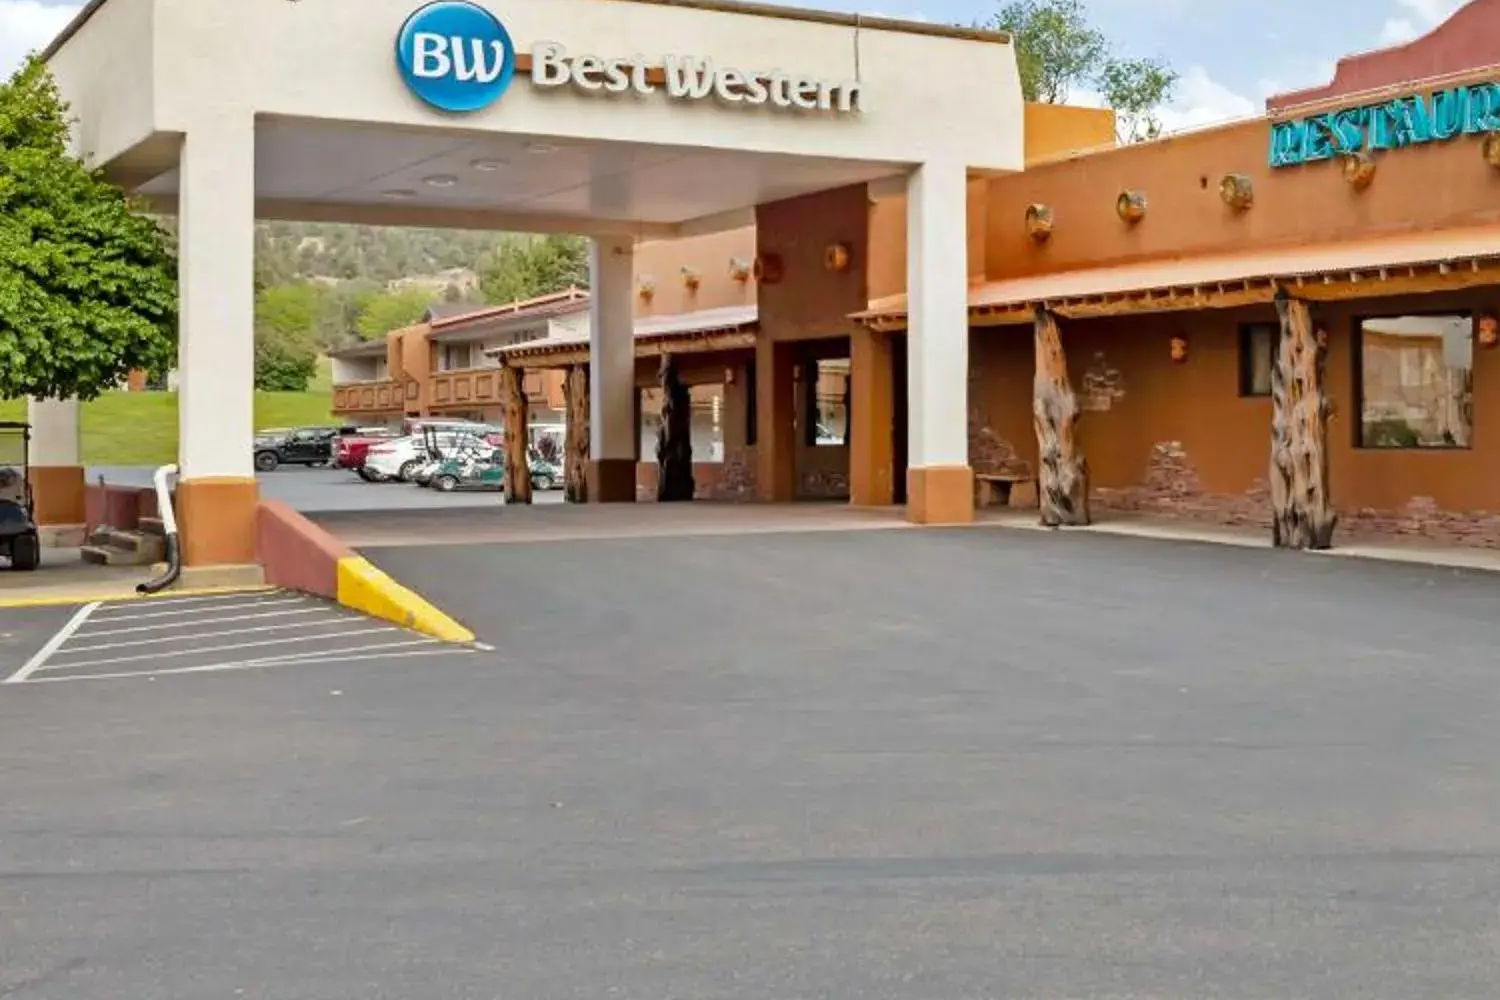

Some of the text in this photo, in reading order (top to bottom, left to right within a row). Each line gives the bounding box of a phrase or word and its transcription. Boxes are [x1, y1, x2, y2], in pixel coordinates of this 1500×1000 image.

[411, 31, 505, 83] BW
[531, 40, 866, 113] Best Western
